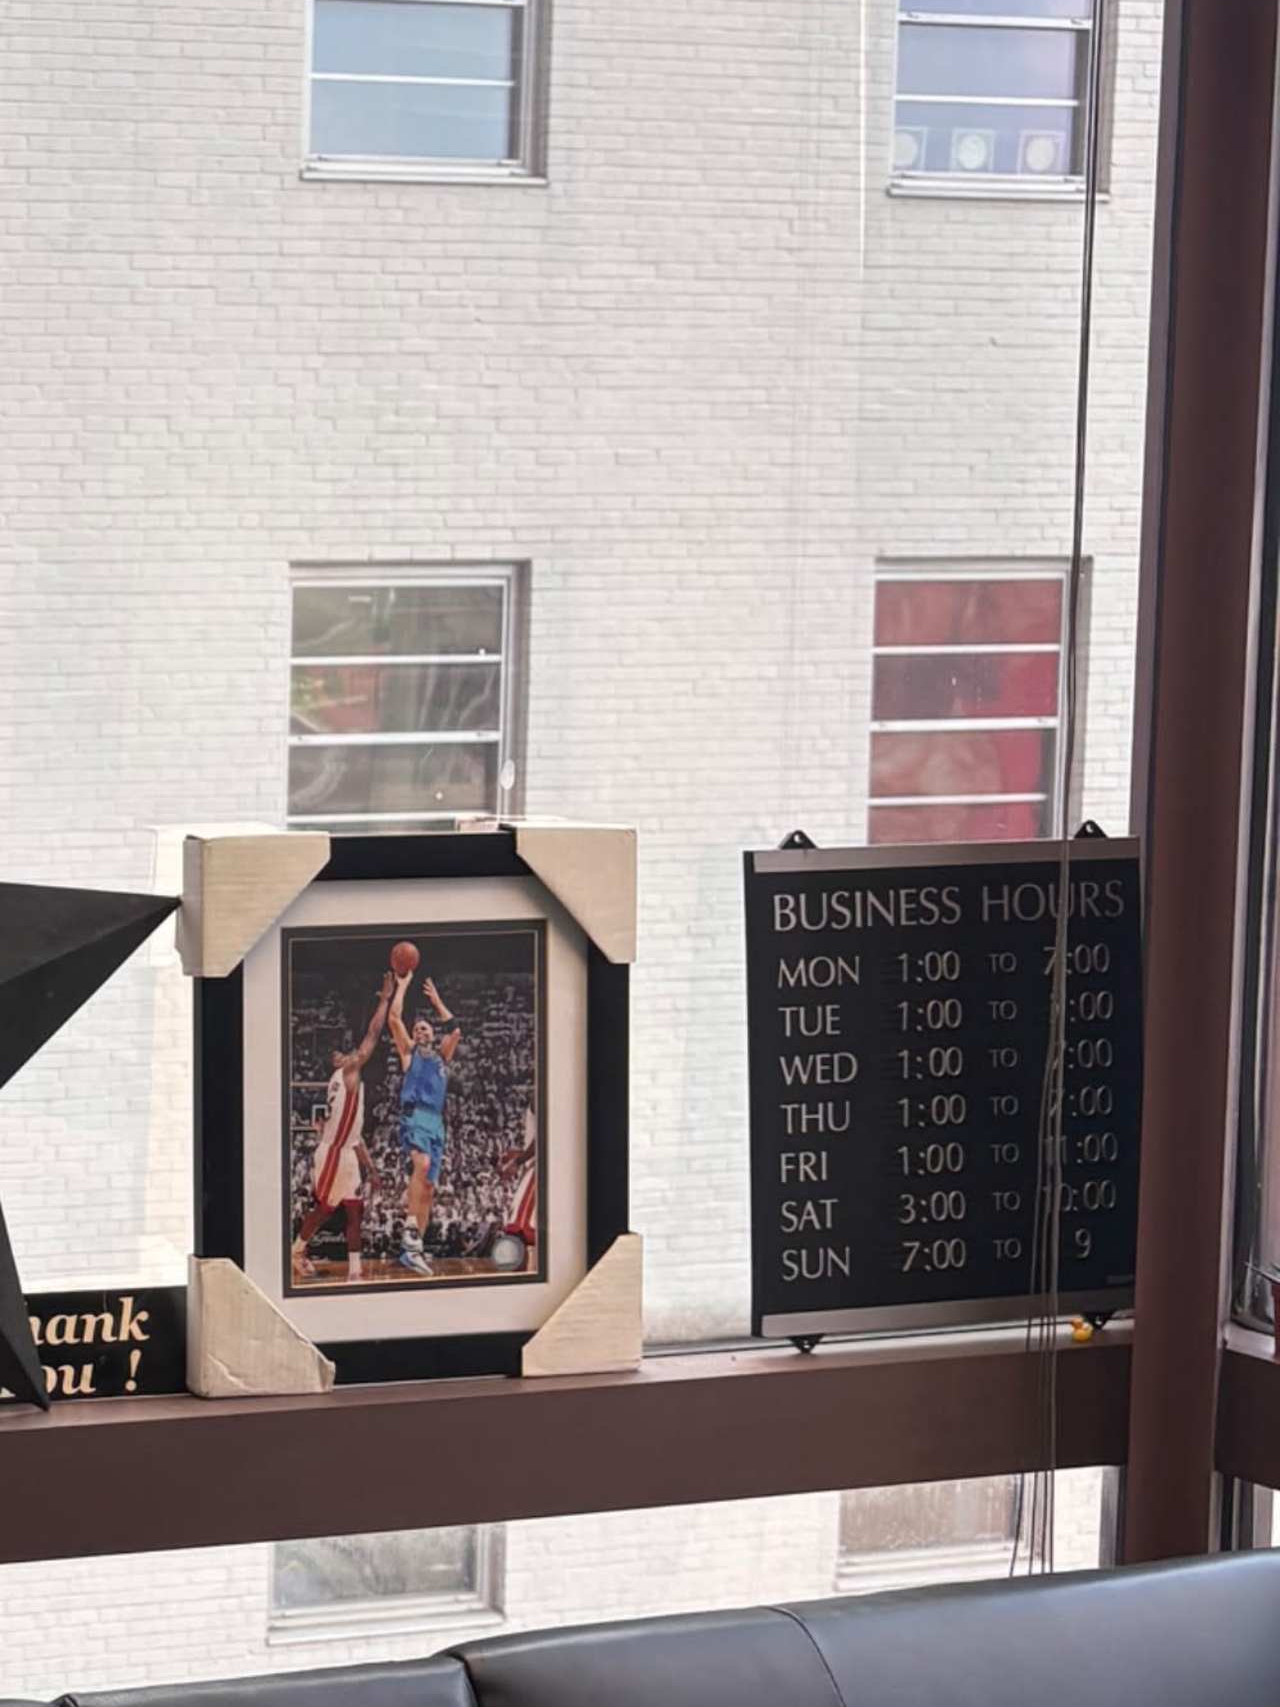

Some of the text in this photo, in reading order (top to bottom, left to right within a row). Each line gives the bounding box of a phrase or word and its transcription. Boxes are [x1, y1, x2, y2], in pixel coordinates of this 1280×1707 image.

[773, 880, 1124, 931] BUSINESS HOURS
[778, 955, 860, 988] MON
[898, 950, 961, 982] 1:00
[989, 952, 1017, 973] TO
[778, 991, 1113, 1037] TUE 1:00 TO :00
[779, 1052, 858, 1085] WED
[898, 1047, 963, 1079] 1:00
[990, 1048, 1018, 1068] TO
[779, 1100, 850, 1134] THU
[898, 1094, 966, 1128] 1:00
[992, 1095, 1019, 1116] TO
[780, 1151, 827, 1183] FRI
[898, 1142, 964, 1175] 1:00
[992, 1142, 1020, 1163] TO
[780, 1198, 839, 1232] SAT
[900, 1190, 966, 1224] 3:00
[993, 1191, 1021, 1211] TO
[782, 1228, 1091, 1281] SUN 7:00 TO 9
